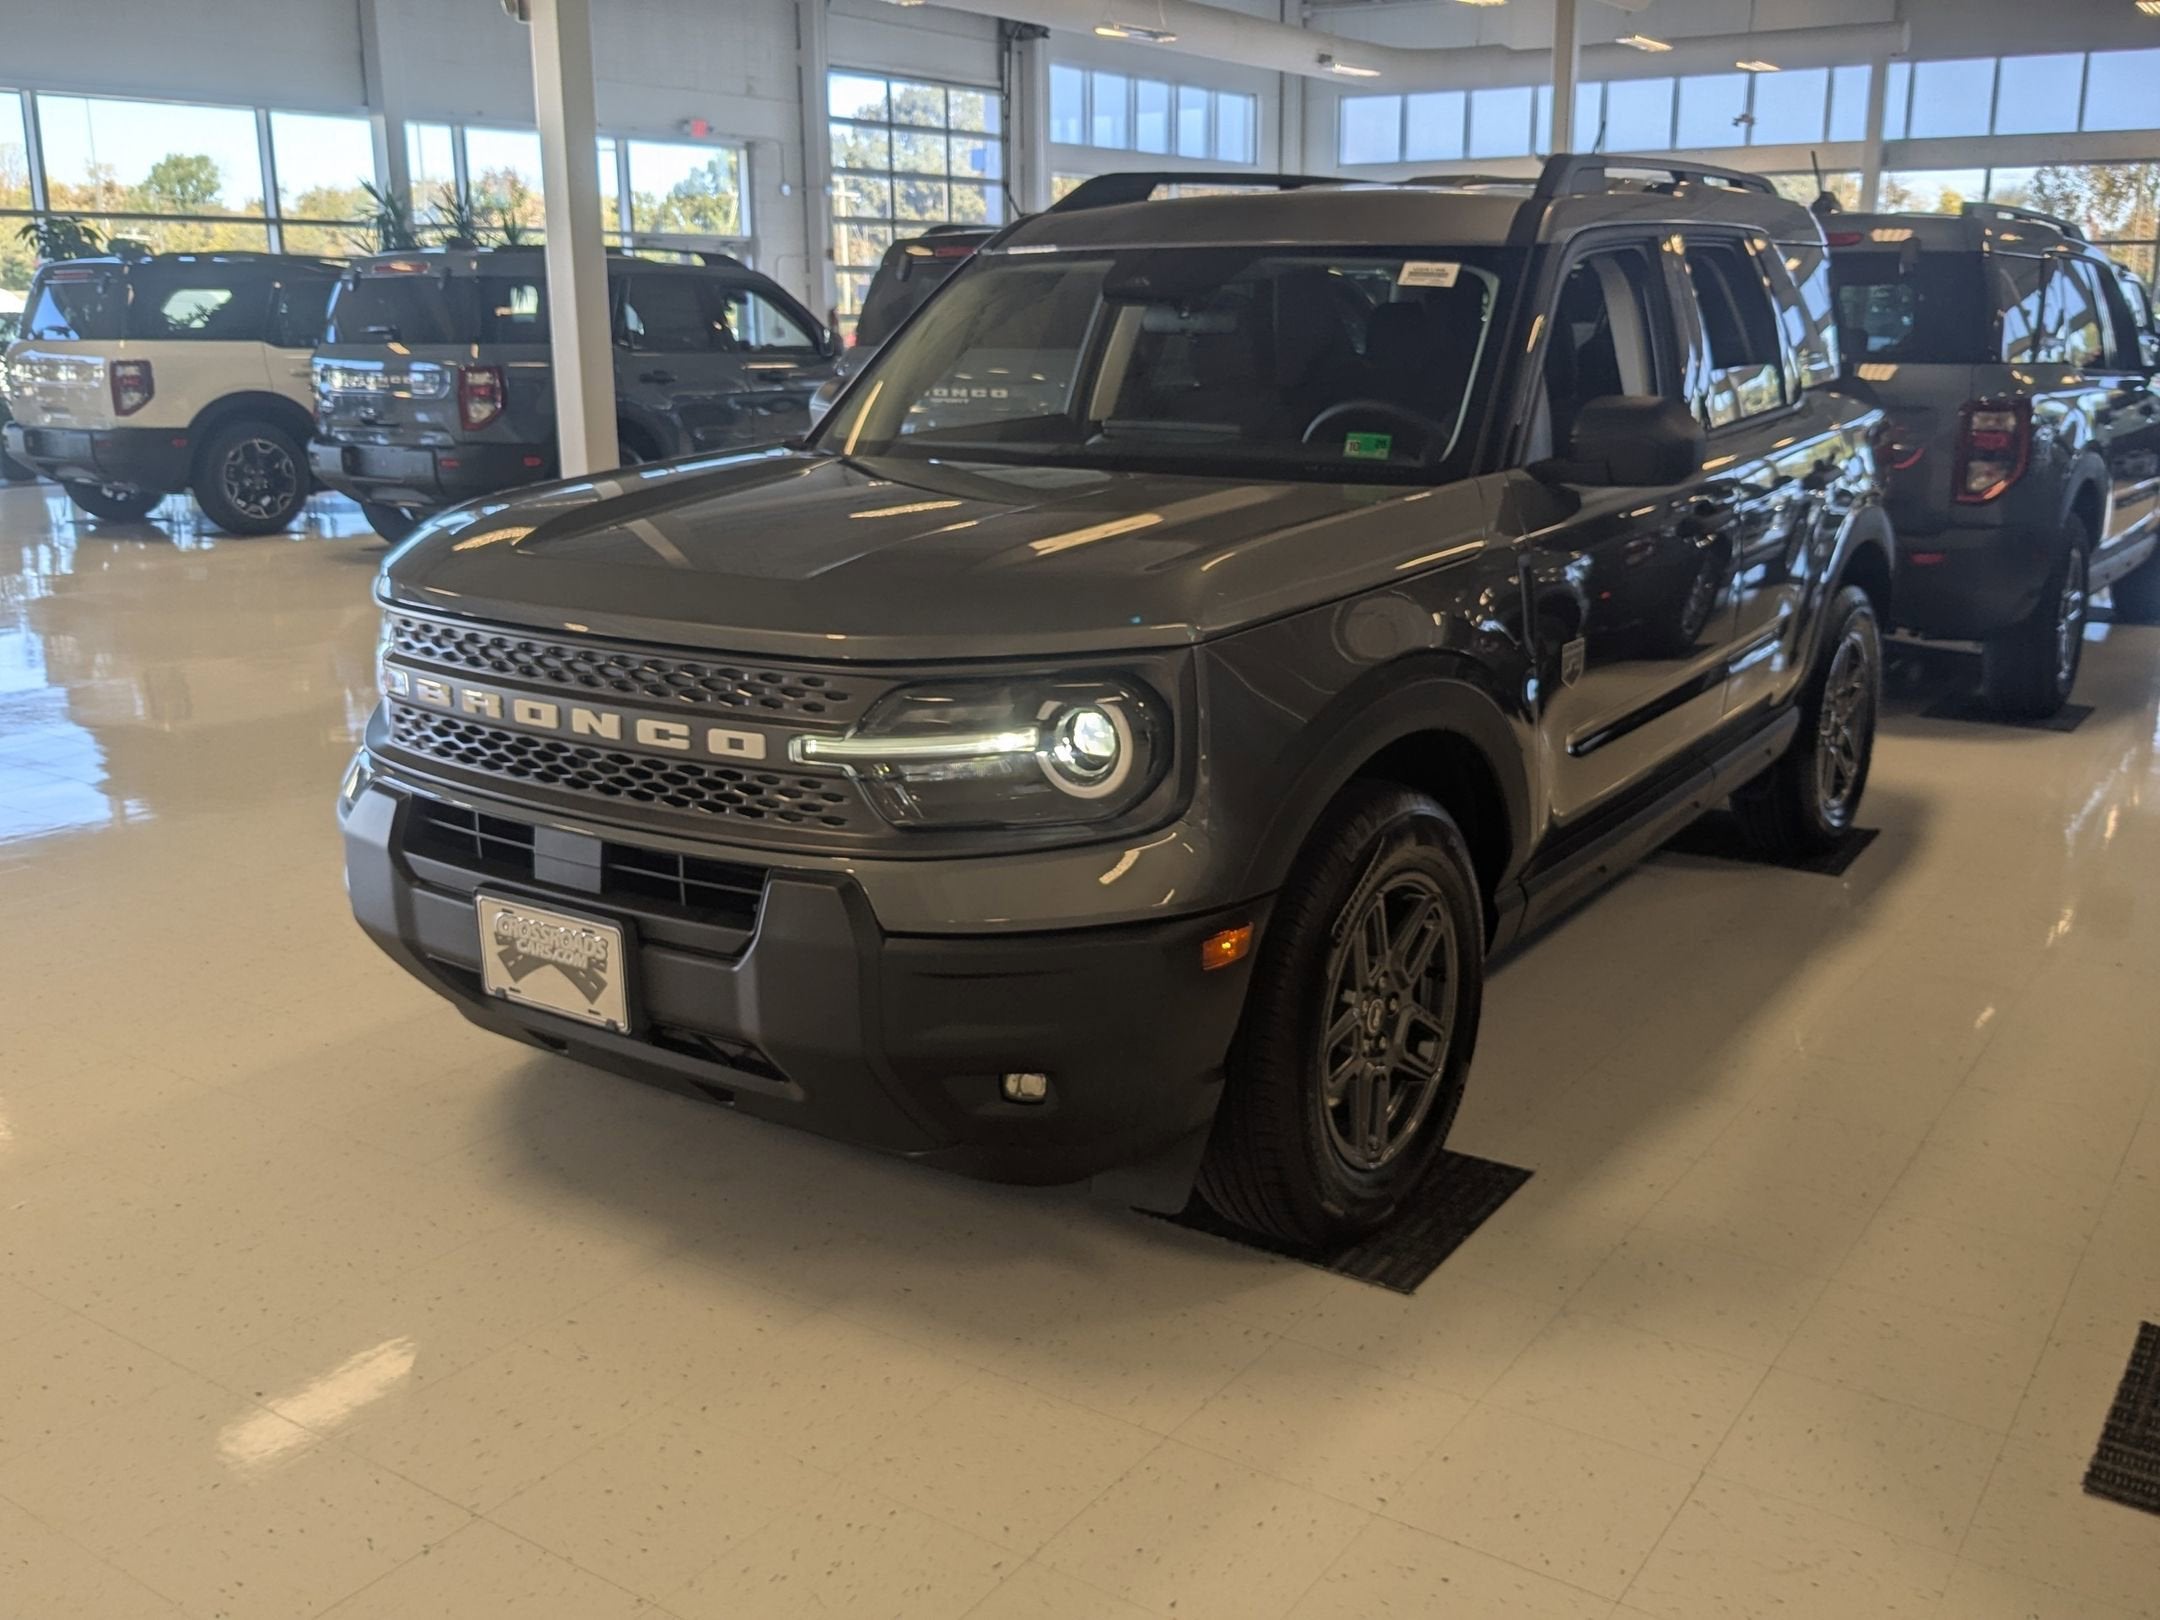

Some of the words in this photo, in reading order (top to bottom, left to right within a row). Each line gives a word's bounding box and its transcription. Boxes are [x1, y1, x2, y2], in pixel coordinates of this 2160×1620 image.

[924, 388, 1008, 398] ONCO
[416, 677, 767, 760] BRONCO
[496, 912, 608, 960] CROSSROADS
[517, 939, 590, 968] CARS.COM
